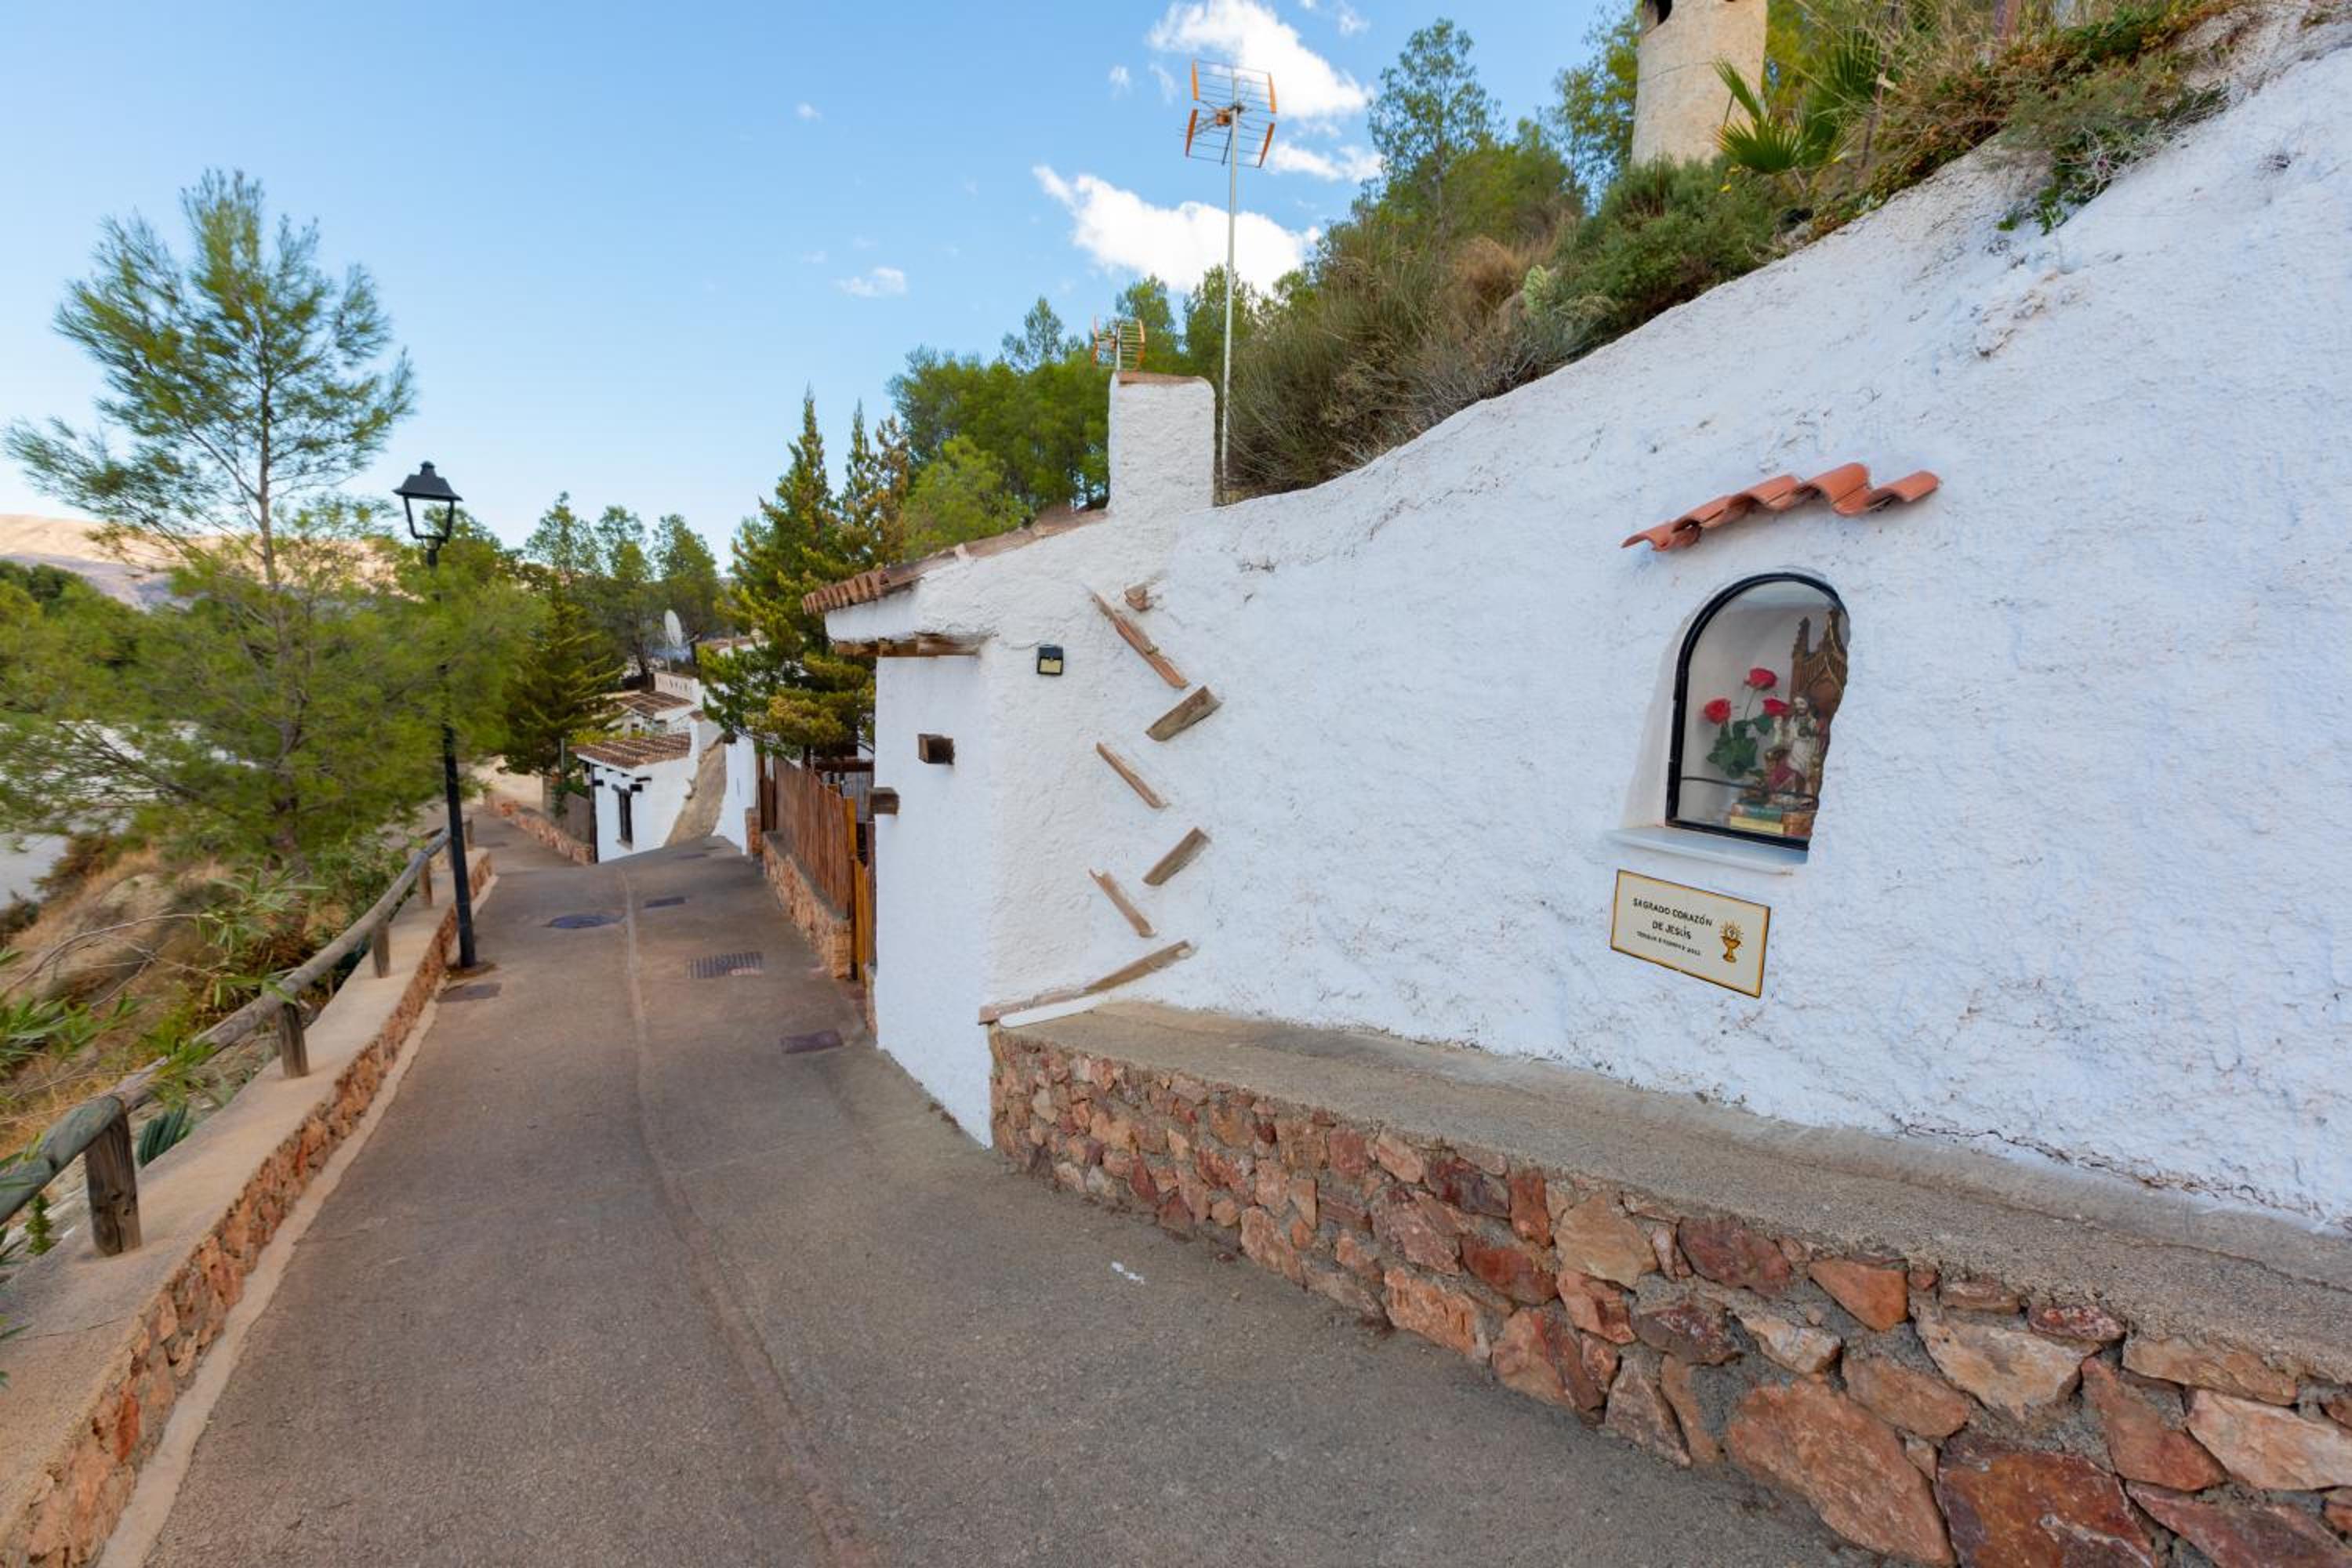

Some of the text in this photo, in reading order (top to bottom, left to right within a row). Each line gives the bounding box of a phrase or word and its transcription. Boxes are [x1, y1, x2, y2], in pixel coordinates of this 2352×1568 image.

[1633, 898, 1712, 927] SAGRADO CORAZÓN
[1652, 921, 1691, 940] DE JESÚS
